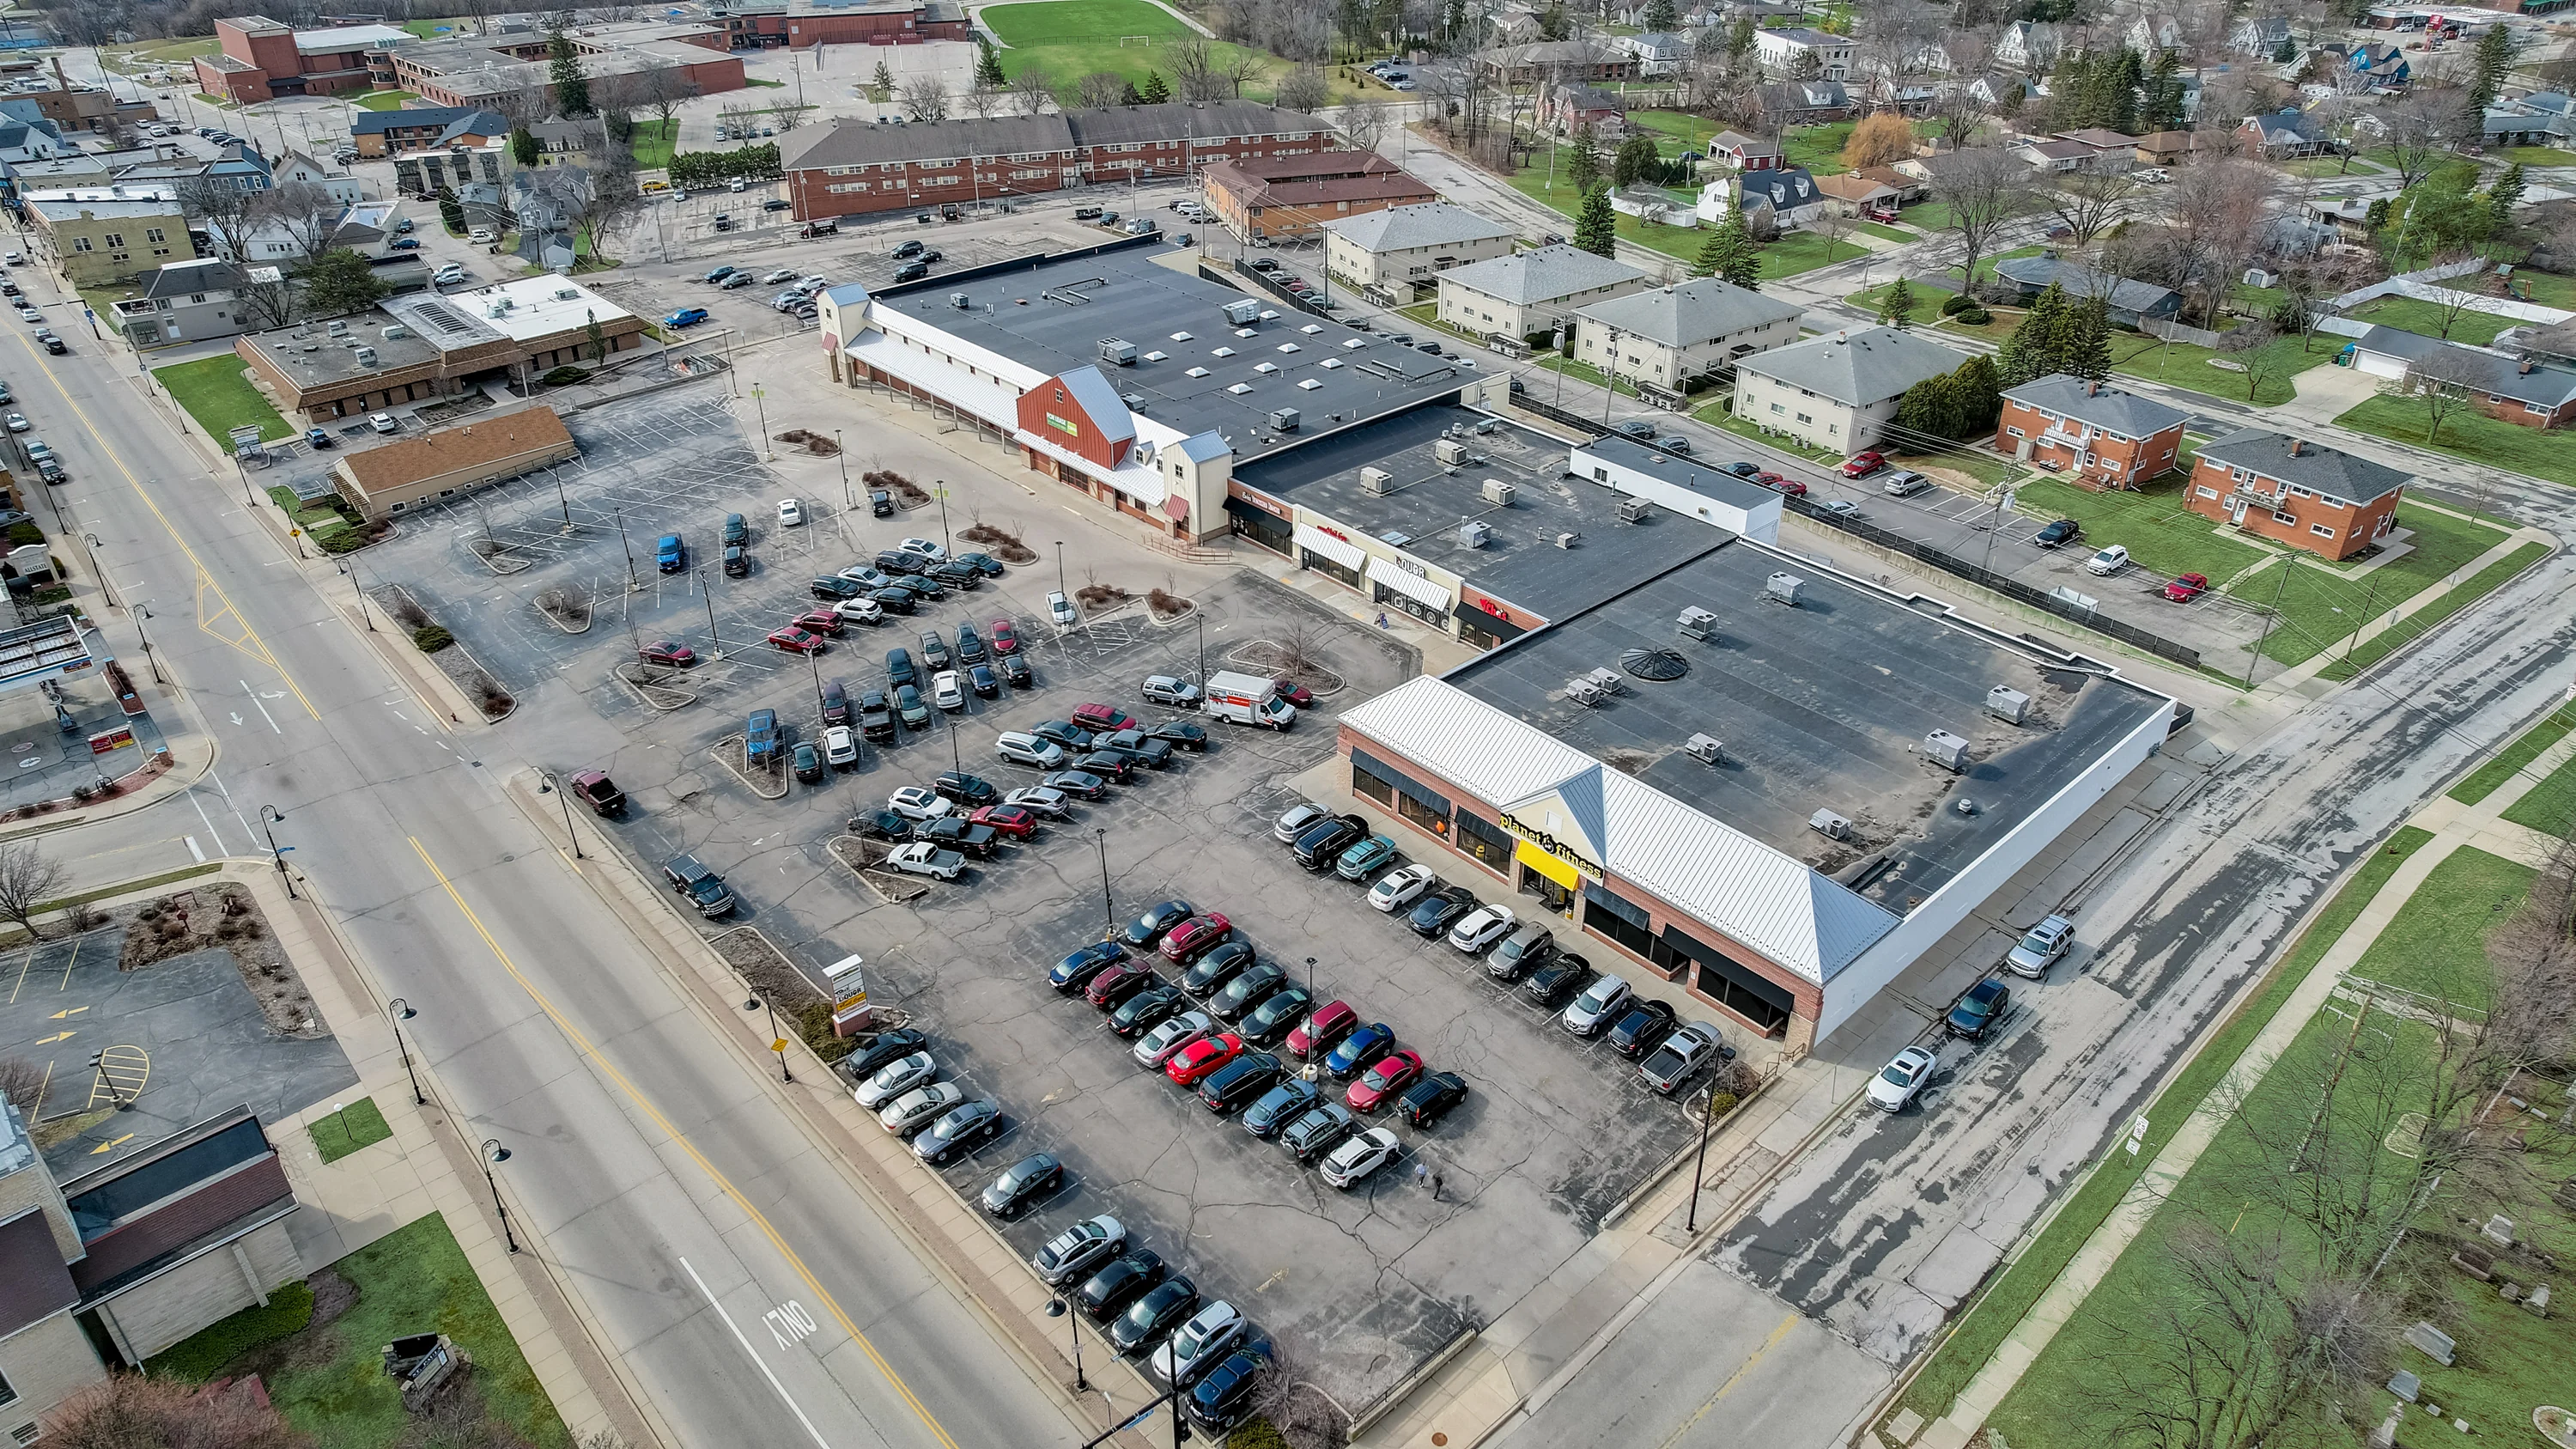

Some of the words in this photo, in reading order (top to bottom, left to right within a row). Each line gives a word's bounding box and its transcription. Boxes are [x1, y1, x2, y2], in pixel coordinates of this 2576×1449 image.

[24, 563, 47, 573] ALLSTATE
[1394, 555, 1425, 579] LIQUOR
[1499, 813, 1542, 846] planet
[1555, 843, 1602, 878] fitness
[762, 1300, 817, 1351] ONLY
